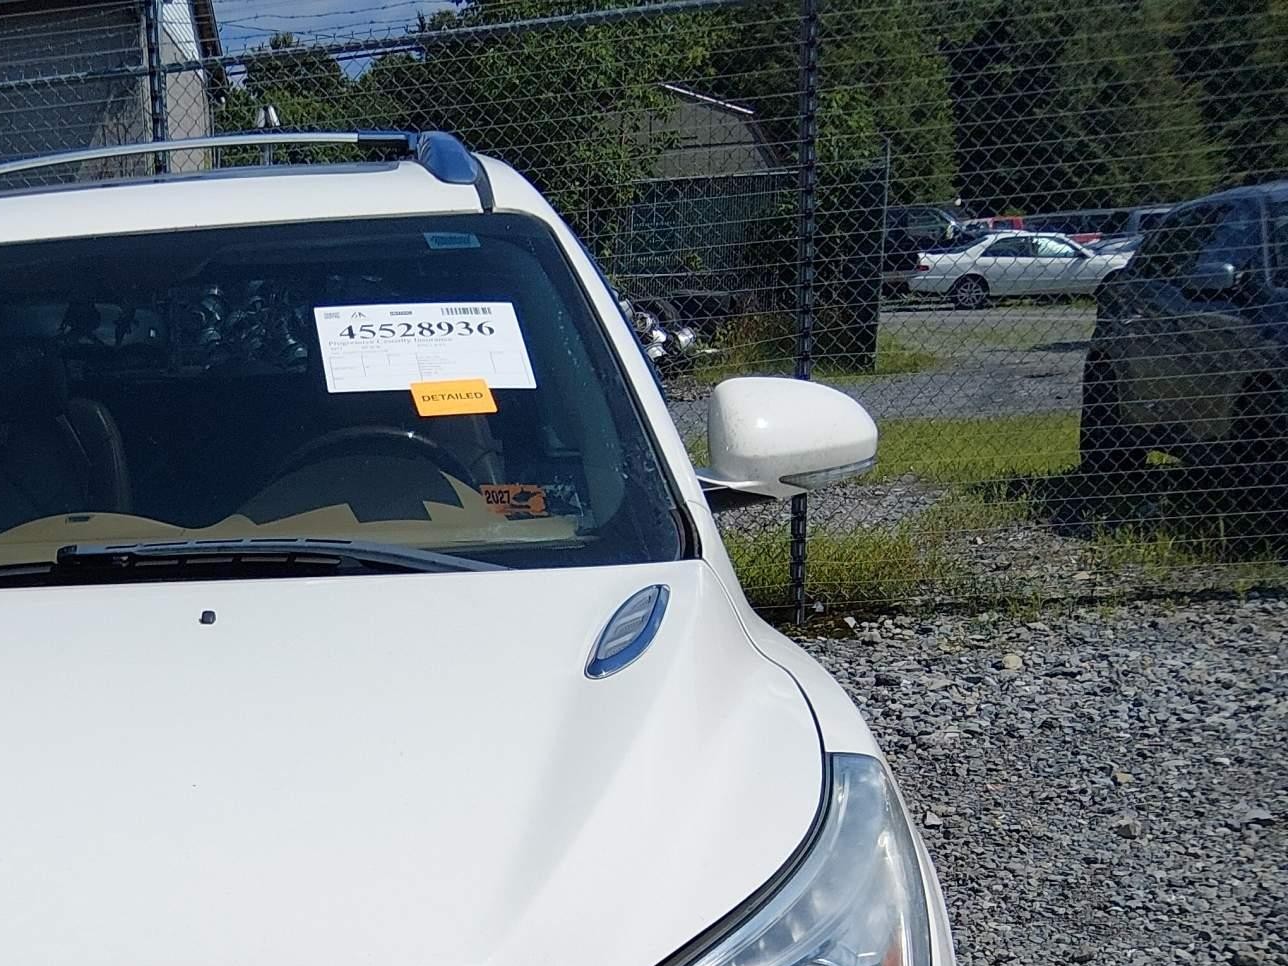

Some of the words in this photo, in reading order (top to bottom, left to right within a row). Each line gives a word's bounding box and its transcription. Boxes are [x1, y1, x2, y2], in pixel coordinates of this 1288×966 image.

[339, 321, 495, 339] 45528936
[421, 391, 484, 403] DETAILED
[485, 490, 511, 505] 2027
